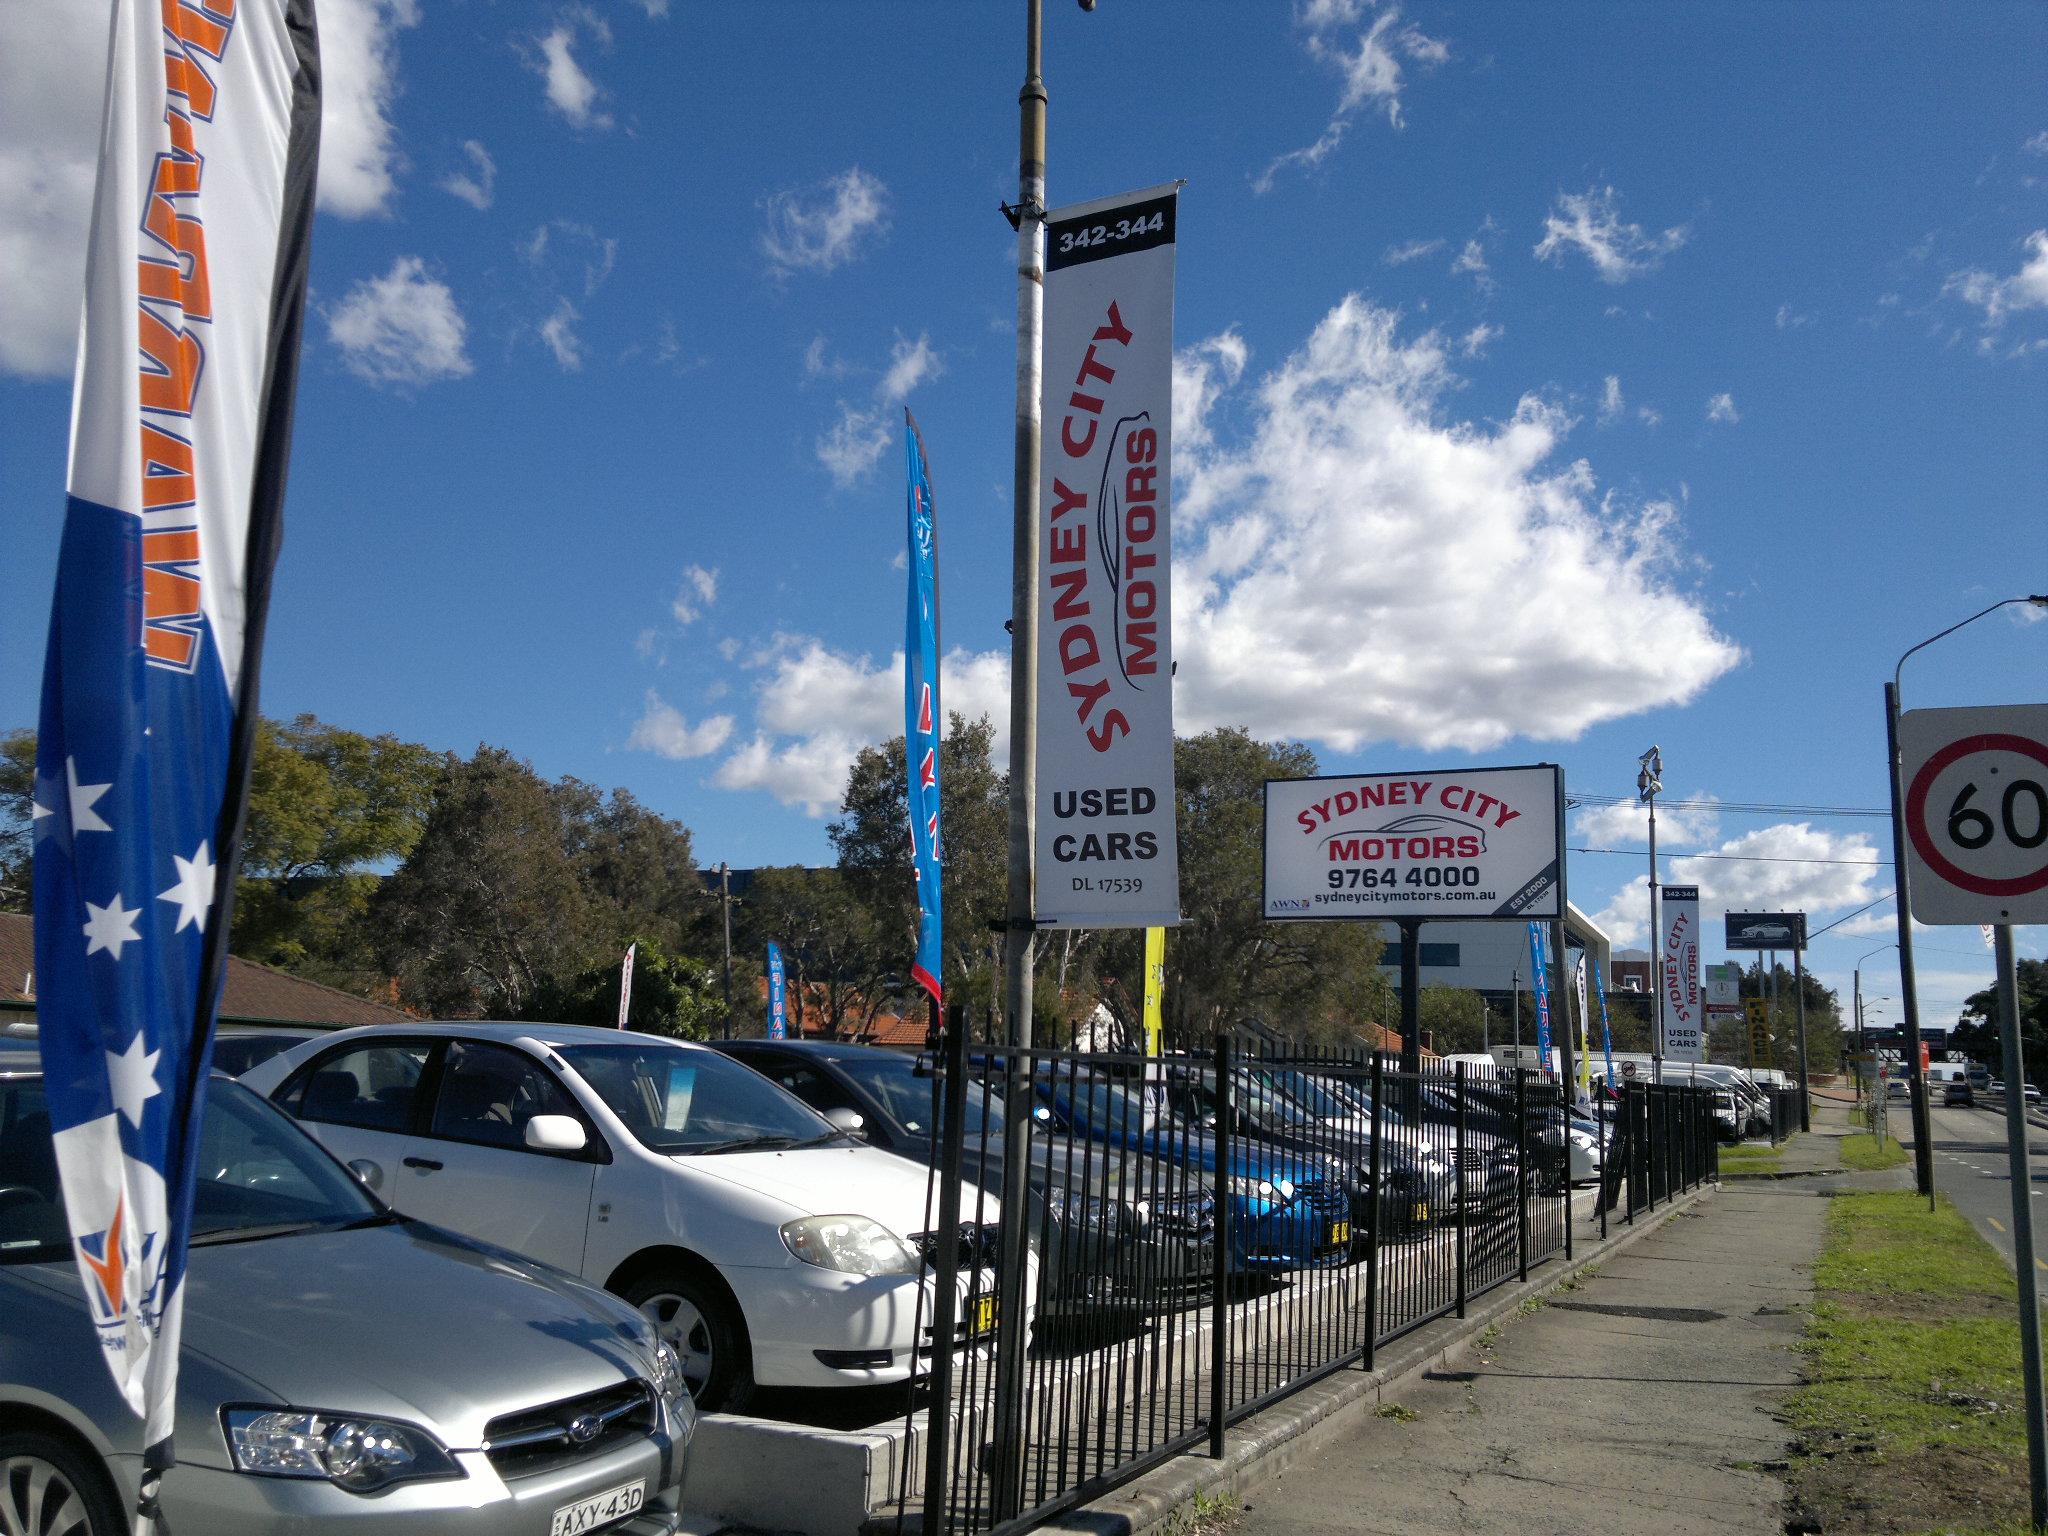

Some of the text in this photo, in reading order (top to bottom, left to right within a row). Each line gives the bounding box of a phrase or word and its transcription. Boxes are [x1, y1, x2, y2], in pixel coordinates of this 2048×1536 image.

[1059, 211, 1164, 253] 342-344
[1050, 299, 1133, 753] SYDNEY CITY
[1125, 427, 1157, 676] MOTORS
[1053, 786, 1156, 819] USED
[1297, 781, 1522, 835] SYDNEY CITY
[1947, 779, 2048, 849] 60
[1052, 831, 1158, 863] CARS
[1329, 835, 1480, 861] MOTORS
[1072, 876, 1143, 893] DL 17539
[1328, 866, 1480, 889] 9764 4000
[1510, 876, 1548, 909] EST 2000
[1314, 890, 1496, 904] sydneycitymotors.com.au
[1666, 912, 1691, 1022] SYDNEY CITY
[1687, 944, 1697, 1005] MOTORS
[1669, 1029, 1697, 1037] USED
[1669, 1040, 1697, 1048] CARS
